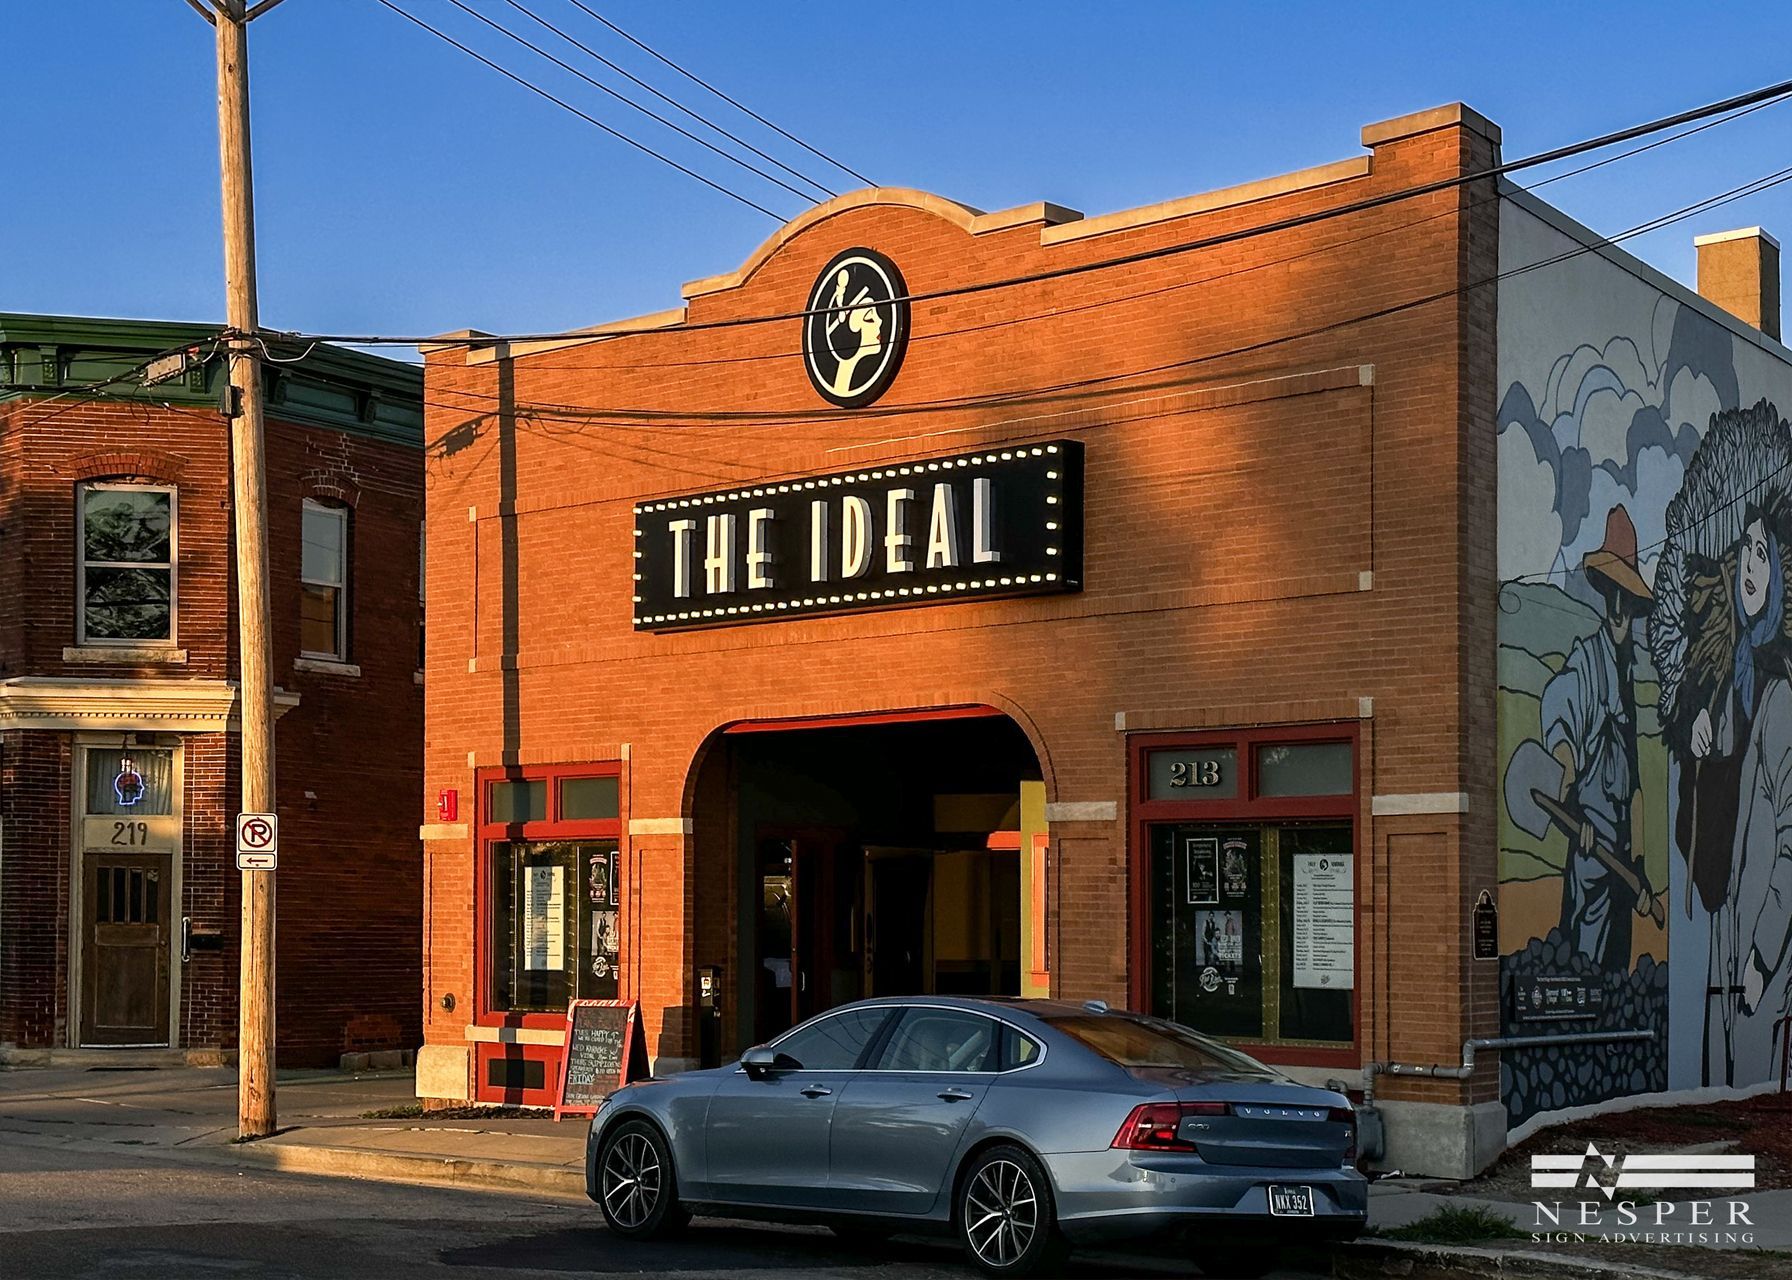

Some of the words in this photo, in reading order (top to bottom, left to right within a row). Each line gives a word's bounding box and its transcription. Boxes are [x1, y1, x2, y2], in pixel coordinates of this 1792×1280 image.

[668, 508, 774, 598] THE
[811, 478, 1000, 582] IDEAL
[1169, 761, 1219, 786] 213
[111, 821, 148, 846] 219
[250, 823, 267, 842] P
[568, 1072, 595, 1084] FRIDAY
[1245, 1108, 1320, 1117] VOLVO
[1292, 1194, 1308, 1210] 352
